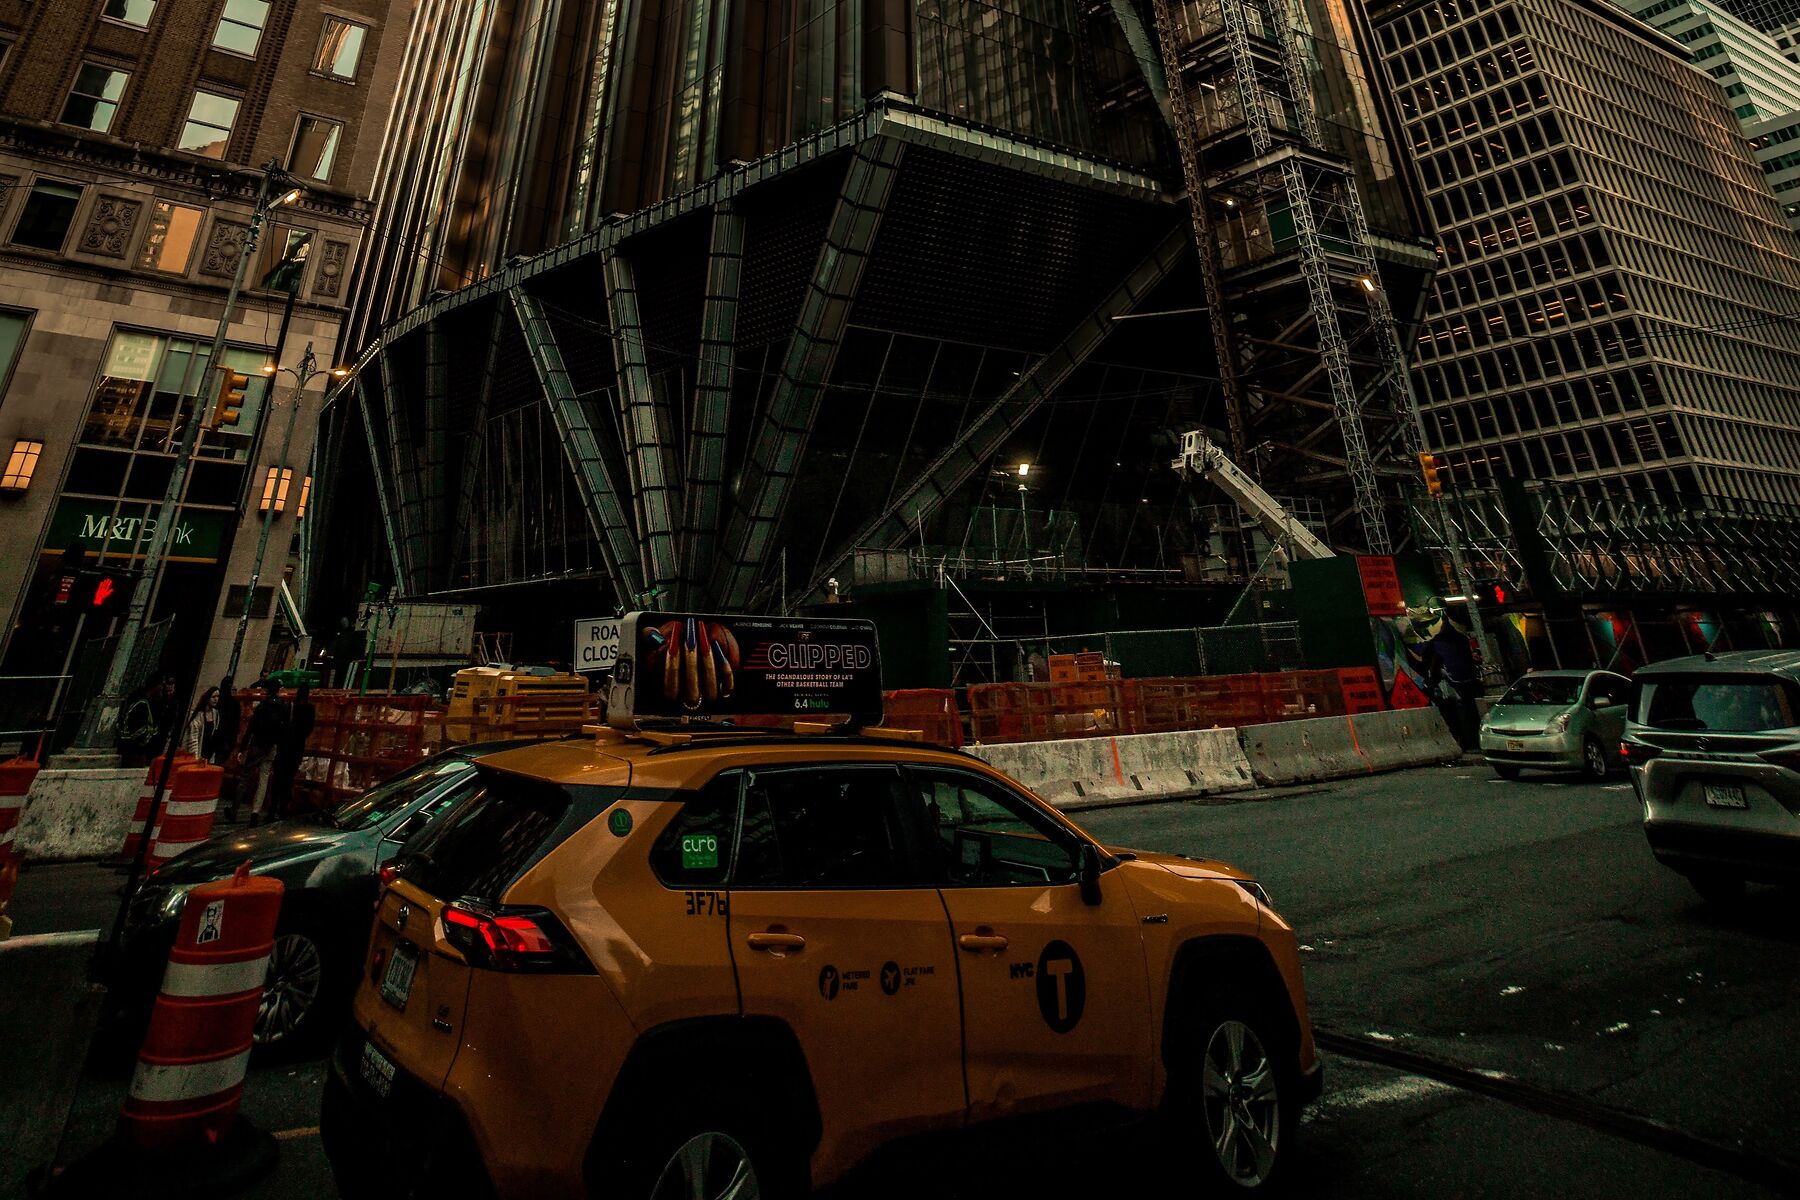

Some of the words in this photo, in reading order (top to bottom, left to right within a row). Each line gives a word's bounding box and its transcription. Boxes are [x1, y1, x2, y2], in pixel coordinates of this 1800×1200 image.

[79, 514, 142, 541] M&T
[140, 518, 194, 545] Bnk
[591, 625, 619, 641] ROA
[583, 645, 617, 662] CLOS
[767, 642, 872, 669] CLIPPED
[765, 673, 776, 681] THE
[777, 673, 814, 681] SCANDALOUS
[815, 673, 833, 681] STORY
[833, 673, 841, 681] OF
[794, 698, 809, 709] 6.4
[809, 698, 830, 709] hulu
[682, 836, 717, 852] curb
[1009, 962, 1034, 979] NYC
[1046, 958, 1073, 1020] T
